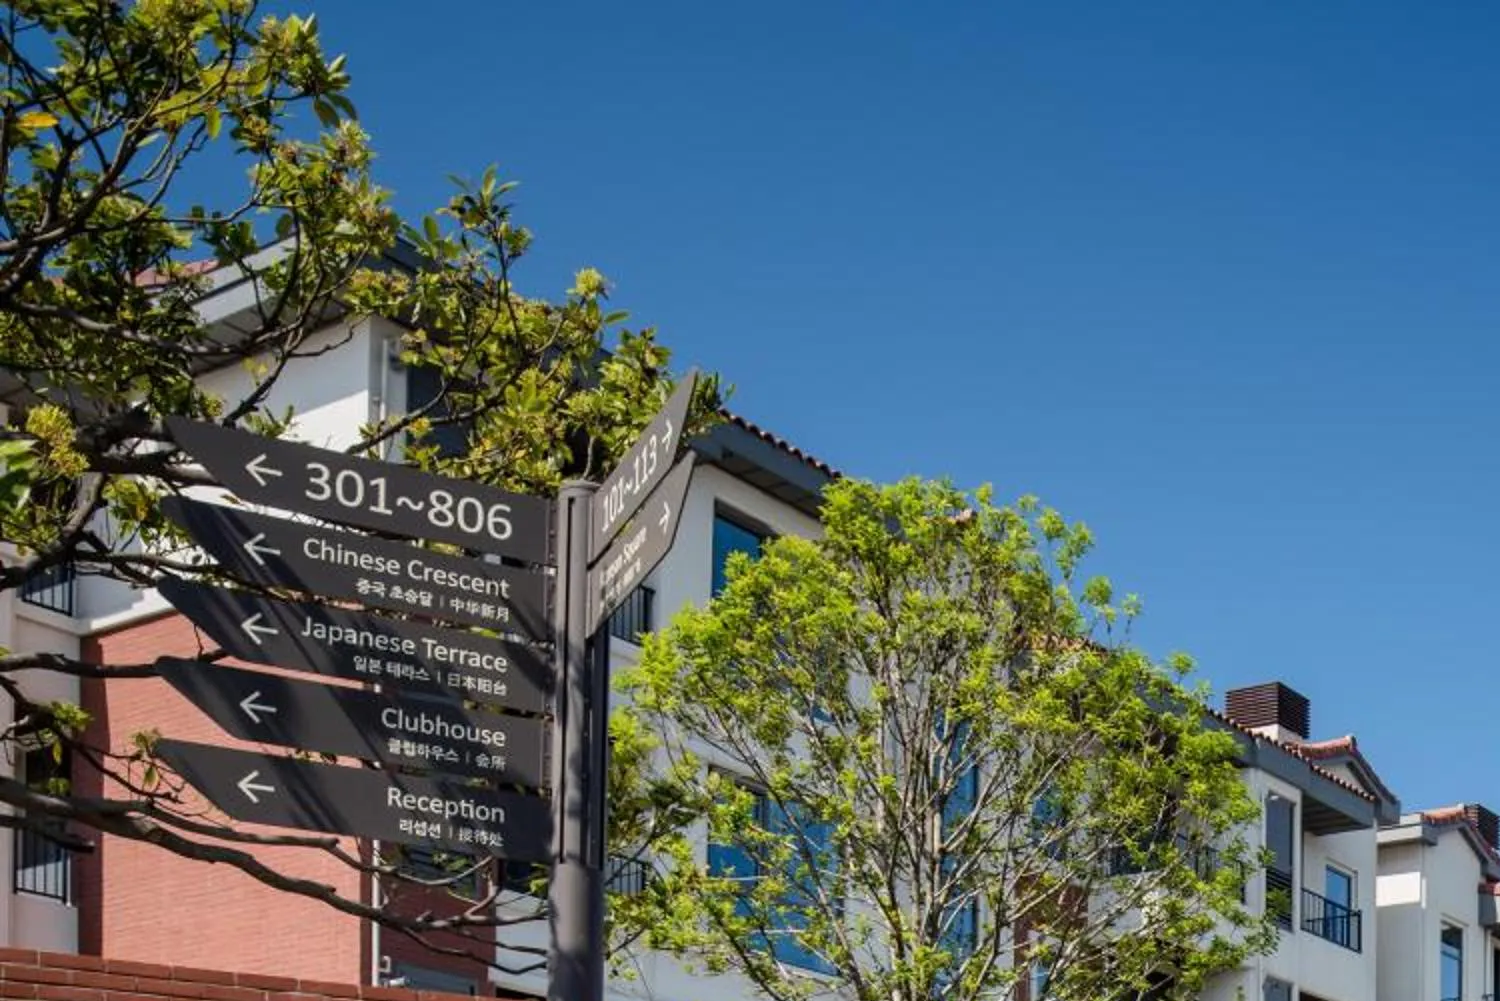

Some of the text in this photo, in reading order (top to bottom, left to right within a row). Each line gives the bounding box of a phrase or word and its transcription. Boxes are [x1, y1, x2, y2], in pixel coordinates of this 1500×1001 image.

[304, 461, 513, 540] 301~806
[601, 433, 658, 533] 101~113
[303, 537, 511, 599] Chinese Crescent
[301, 615, 509, 673] Japanese Terrace
[353, 655, 431, 682] 일본 테라스
[381, 707, 506, 747] Clubhouse
[387, 738, 460, 763] 클럽하우스
[386, 786, 506, 824] Reception
[399, 818, 442, 839] 리셉션
